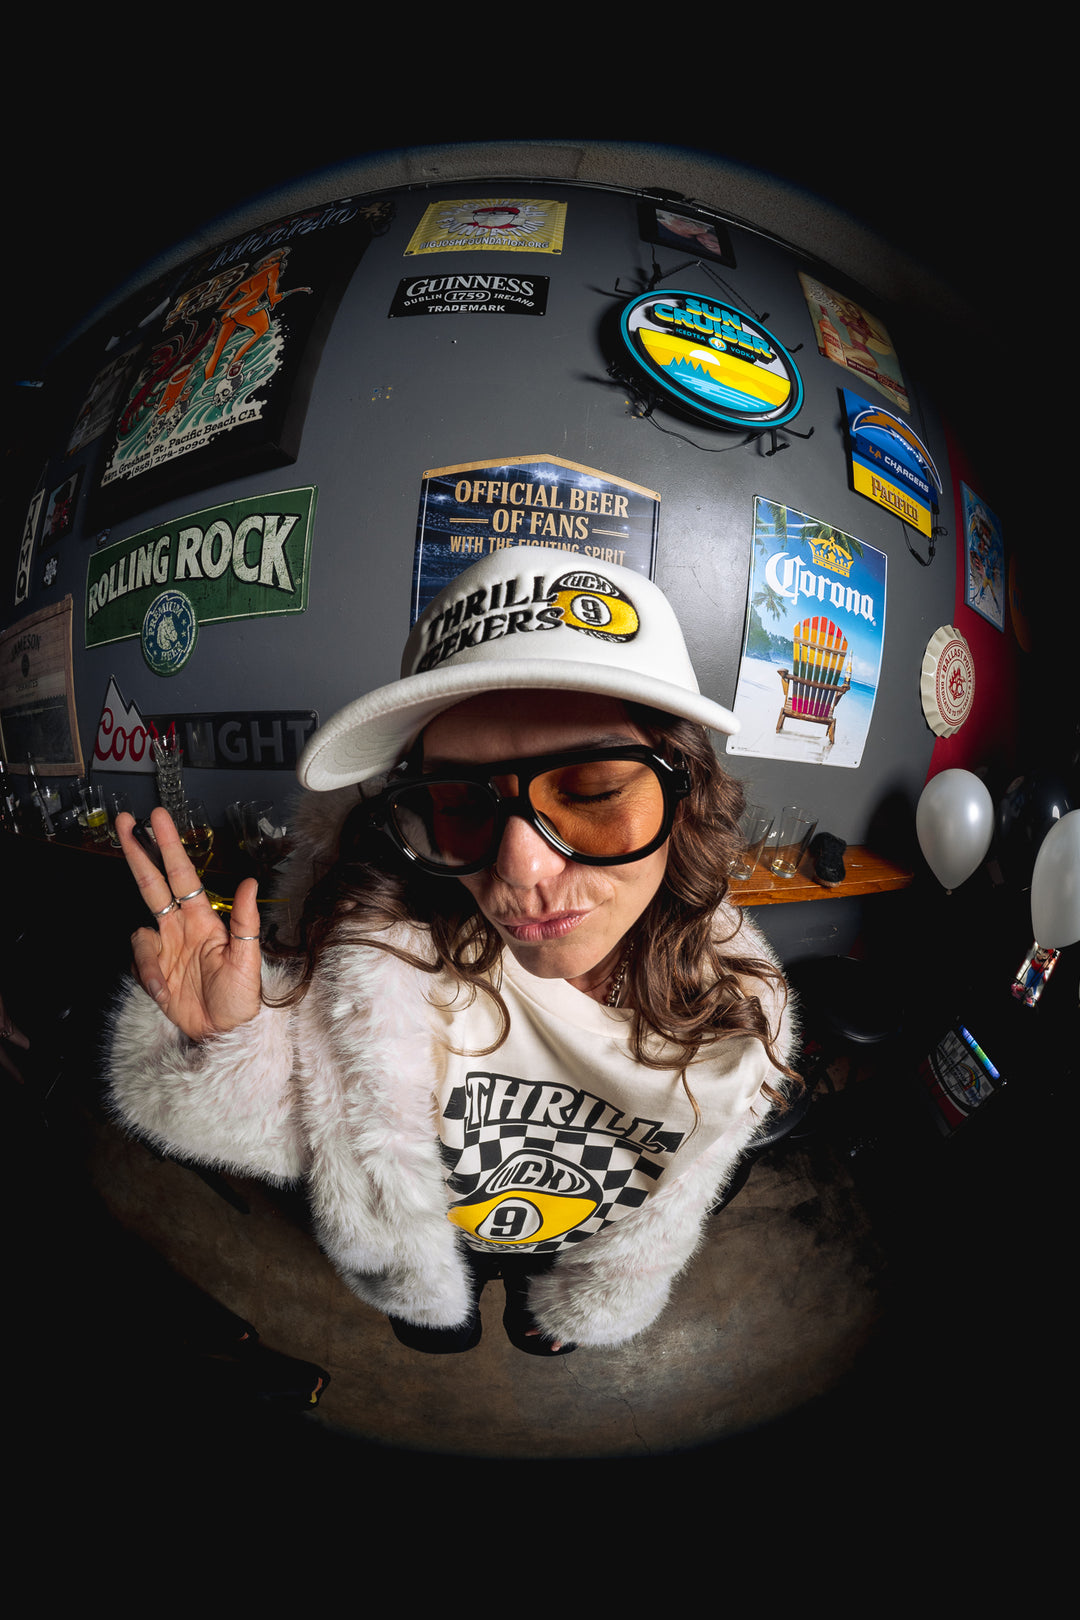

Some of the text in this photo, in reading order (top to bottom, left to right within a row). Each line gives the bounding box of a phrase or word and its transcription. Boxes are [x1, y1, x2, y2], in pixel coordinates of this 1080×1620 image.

[419, 236, 549, 250] BIGJOSHFOUNDATION.ORG
[403, 292, 535, 308] DUBLIN 1759 IRELAND
[406, 275, 535, 297] GUINNESS
[427, 304, 506, 313] TRADEMARK
[685, 298, 742, 331] SUN
[654, 303, 773, 359] CRUISER
[730, 346, 756, 360] VODKA
[118, 451, 151, 474] Gresham
[168, 429, 202, 449] Pacific
[203, 415, 237, 435] Beach
[238, 408, 257, 422] CA
[131, 437, 206, 477] (858) 274-9090
[868, 445, 930, 494] LA CHARGERS
[454, 480, 629, 519] OFFICIAL BEER
[492, 509, 590, 540] OF FANS
[88, 514, 301, 621] ROLLING ROCK
[450, 535, 484, 554] WITH
[584, 545, 626, 567] SPIRIT
[765, 552, 876, 622] Corona
[148, 602, 184, 636] PREMIUM
[428, 575, 559, 646] THRILL
[581, 599, 602, 624] 9
[160, 641, 183, 662] BEER
[942, 648, 972, 683] BALLAST POINT
[185, 720, 313, 763] LIGHT
[466, 1072, 667, 1155] THRILL
[489, 1206, 528, 1240] 9
